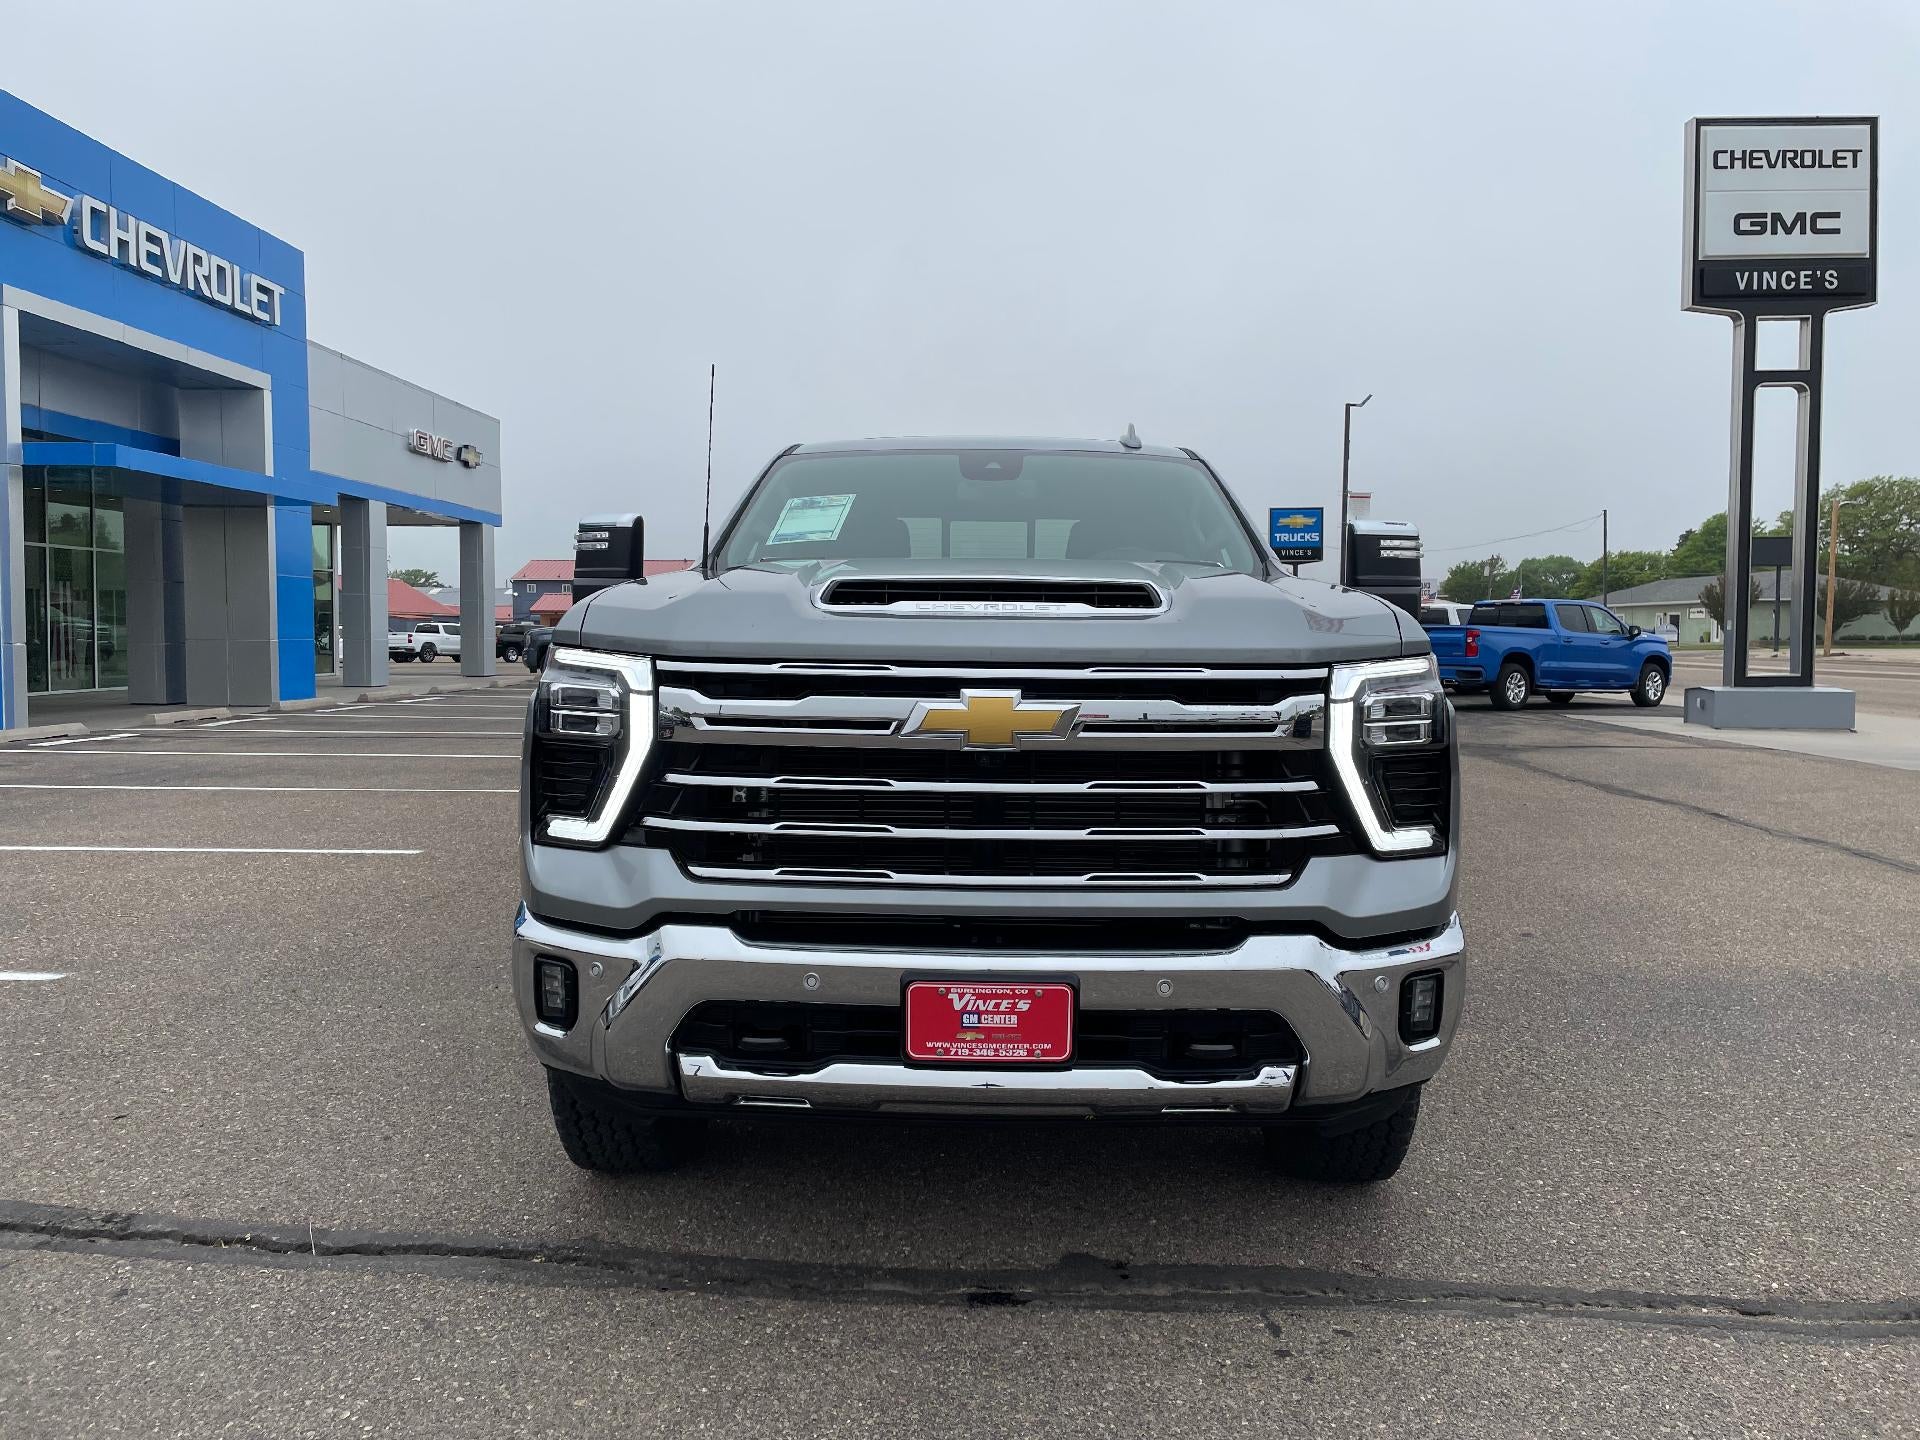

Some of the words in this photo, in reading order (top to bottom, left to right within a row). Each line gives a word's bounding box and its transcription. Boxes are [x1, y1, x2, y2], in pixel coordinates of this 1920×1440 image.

[1712, 149, 1863, 170] CHEVROLET
[1733, 211, 1841, 236] GMC
[79, 194, 285, 326] CHEVROLET
[1735, 269, 1839, 291] VINCE'S
[410, 428, 455, 463] GMC
[1274, 532, 1320, 542] TRUCKS
[915, 603, 1067, 612] CHEVROLET
[950, 987, 1013, 995] BURLINGTON,
[962, 1013, 978, 1024] GM
[981, 1014, 1018, 1025] CENTER
[949, 1048, 1028, 1057] 719-346-5326
